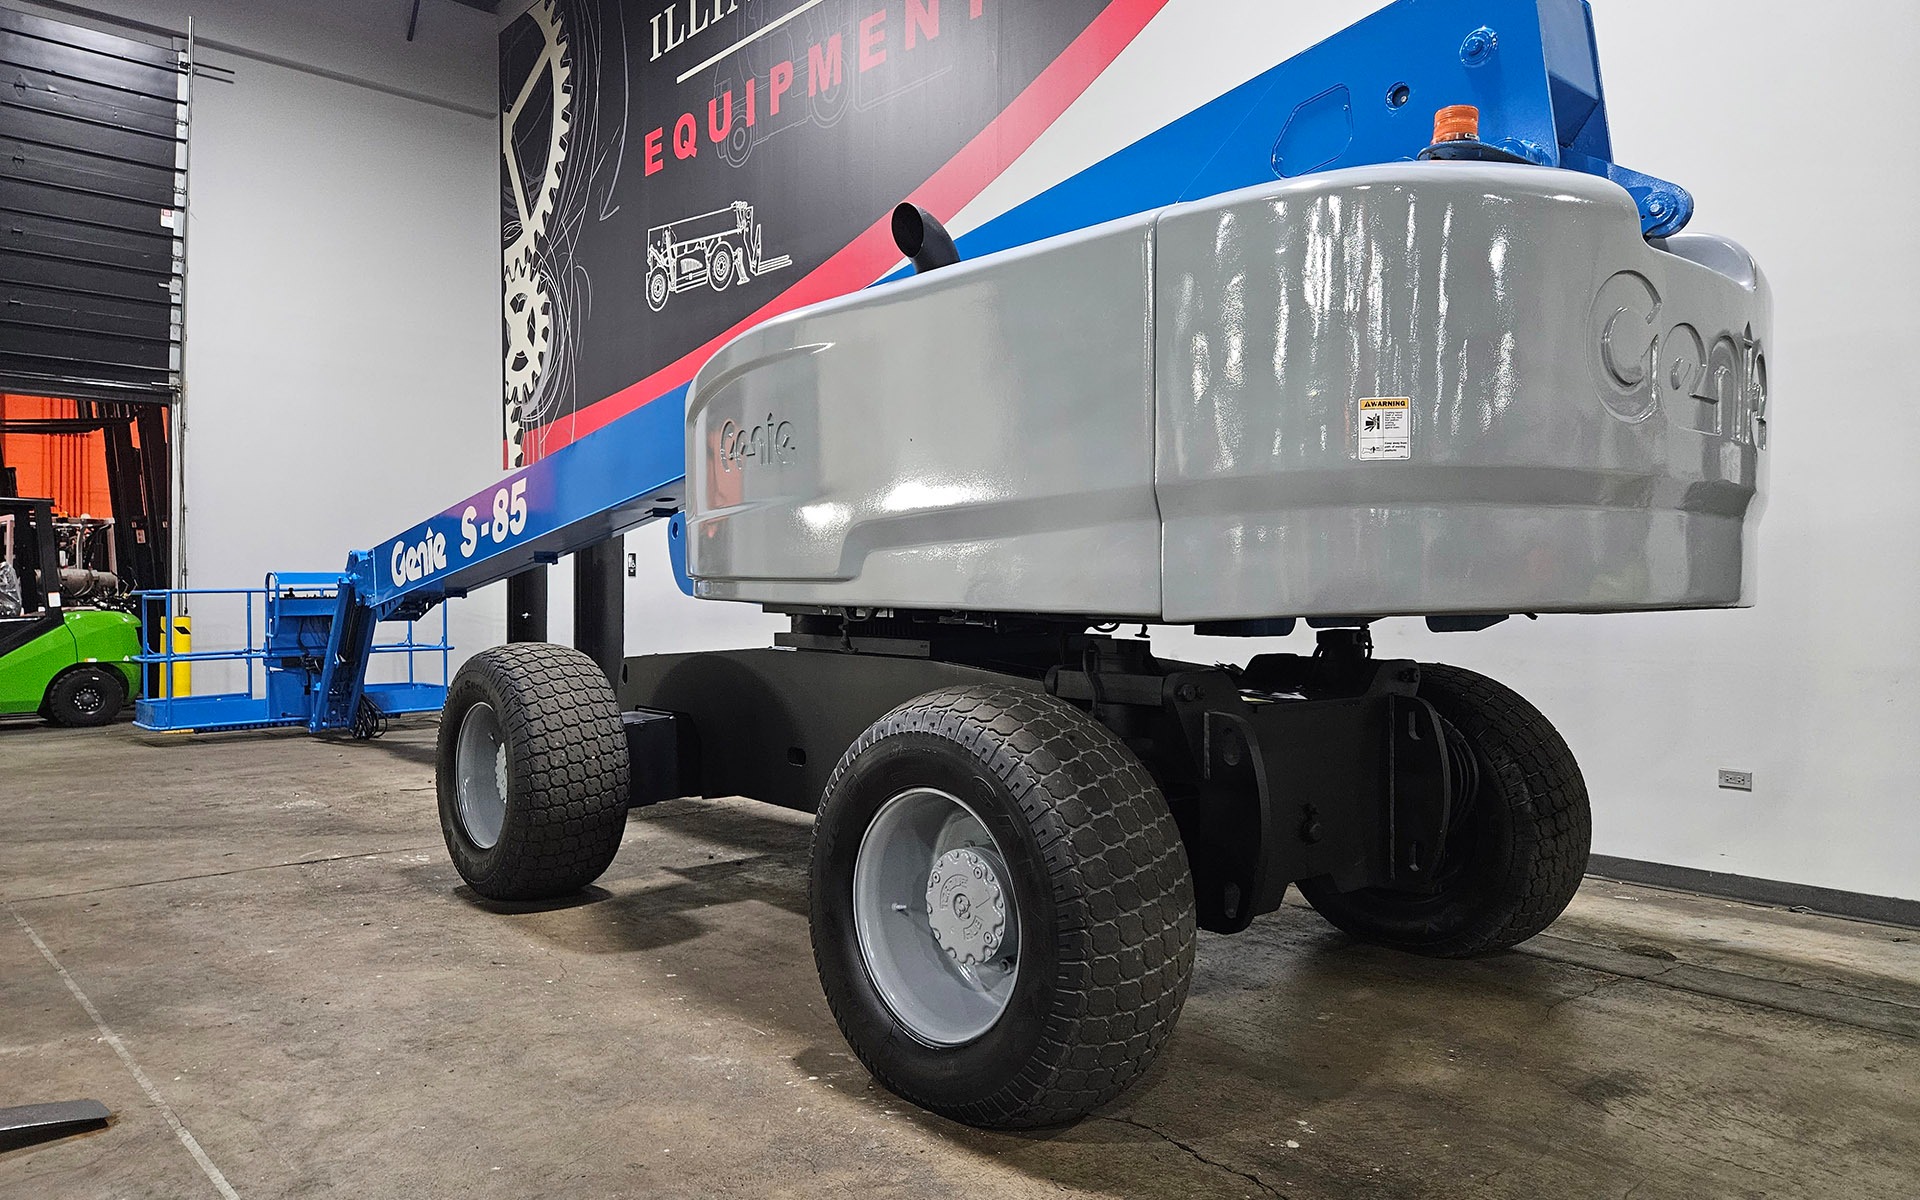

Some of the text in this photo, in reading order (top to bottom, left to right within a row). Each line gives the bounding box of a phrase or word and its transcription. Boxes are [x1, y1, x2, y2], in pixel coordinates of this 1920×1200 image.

[1585, 269, 1768, 450] Genie
[720, 412, 797, 473] Genie
[391, 477, 527, 588] Genie S-85
